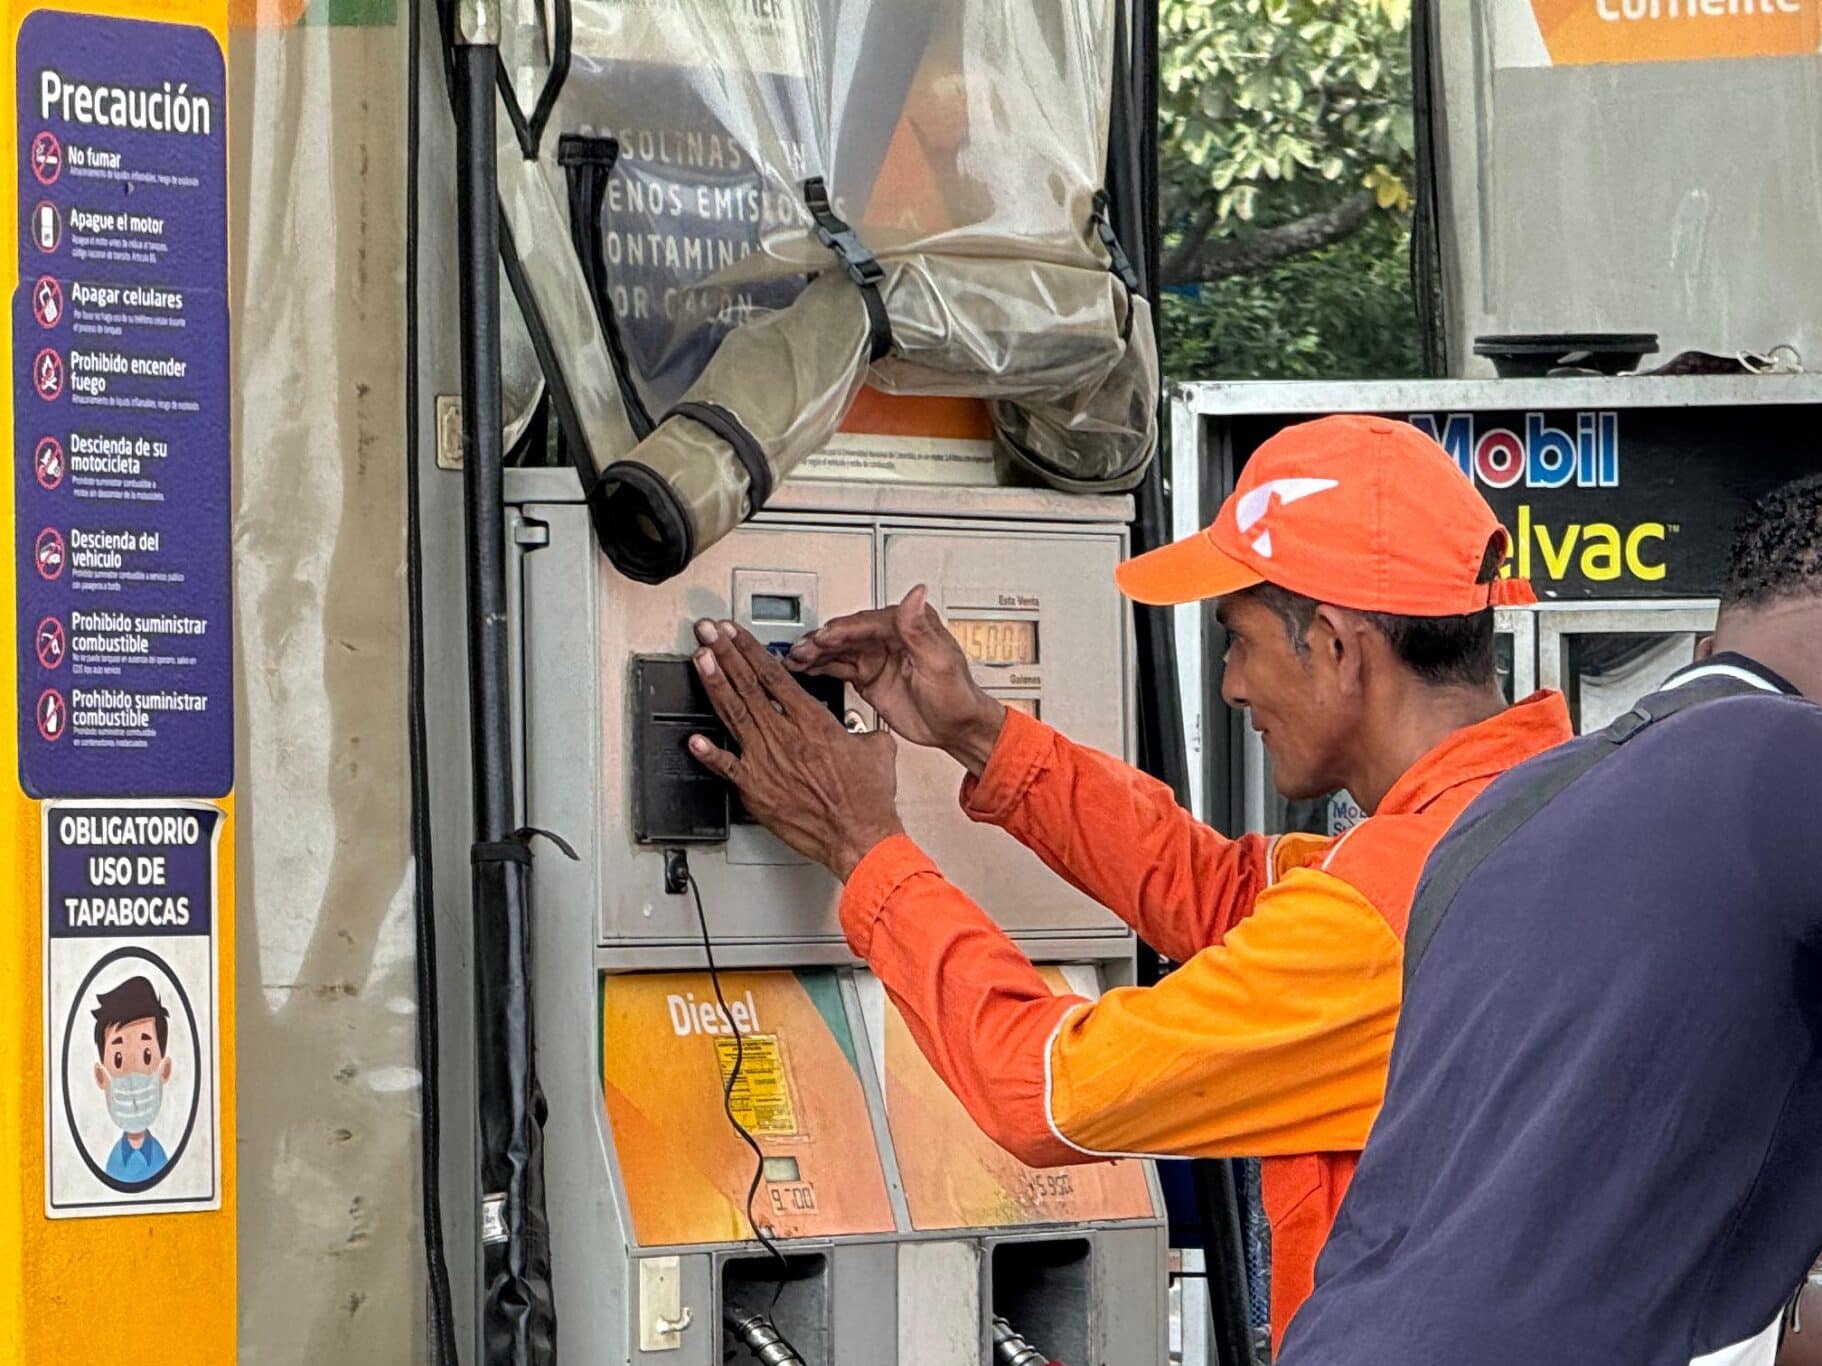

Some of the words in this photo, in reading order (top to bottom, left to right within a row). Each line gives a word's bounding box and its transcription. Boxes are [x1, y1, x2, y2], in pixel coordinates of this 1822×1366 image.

[41, 70, 210, 135] Precaución
[68, 146, 84, 165] No
[87, 147, 121, 169] fumar
[608, 178, 683, 217] ENOS
[70, 208, 114, 233] Apague
[117, 212, 127, 231] el
[130, 217, 164, 234] motor
[72, 282, 119, 307] Apagar
[123, 287, 183, 309] celulares
[70, 351, 128, 374] Prohibido
[131, 357, 187, 377] encender
[71, 372, 106, 395] fuego
[71, 434, 132, 454] Descienda
[135, 437, 149, 456] de
[153, 441, 168, 457] su
[1408, 411, 1619, 488] Mobil
[71, 454, 140, 474] motocicleta
[71, 529, 136, 551] Descienda
[139, 531, 159, 551] del
[72, 611, 132, 632] Prohibido
[134, 614, 207, 634] suministrar
[72, 634, 149, 653] combustible
[72, 689, 133, 709] Prohibido
[135, 691, 208, 711] suministrar
[72, 708, 149, 728] combustible
[60, 816, 199, 845] OBLIGATORIO
[89, 856, 133, 886] USO
[137, 857, 166, 886] DE
[65, 897, 190, 927] TAPABOCAS
[667, 990, 761, 1037] Diesel
